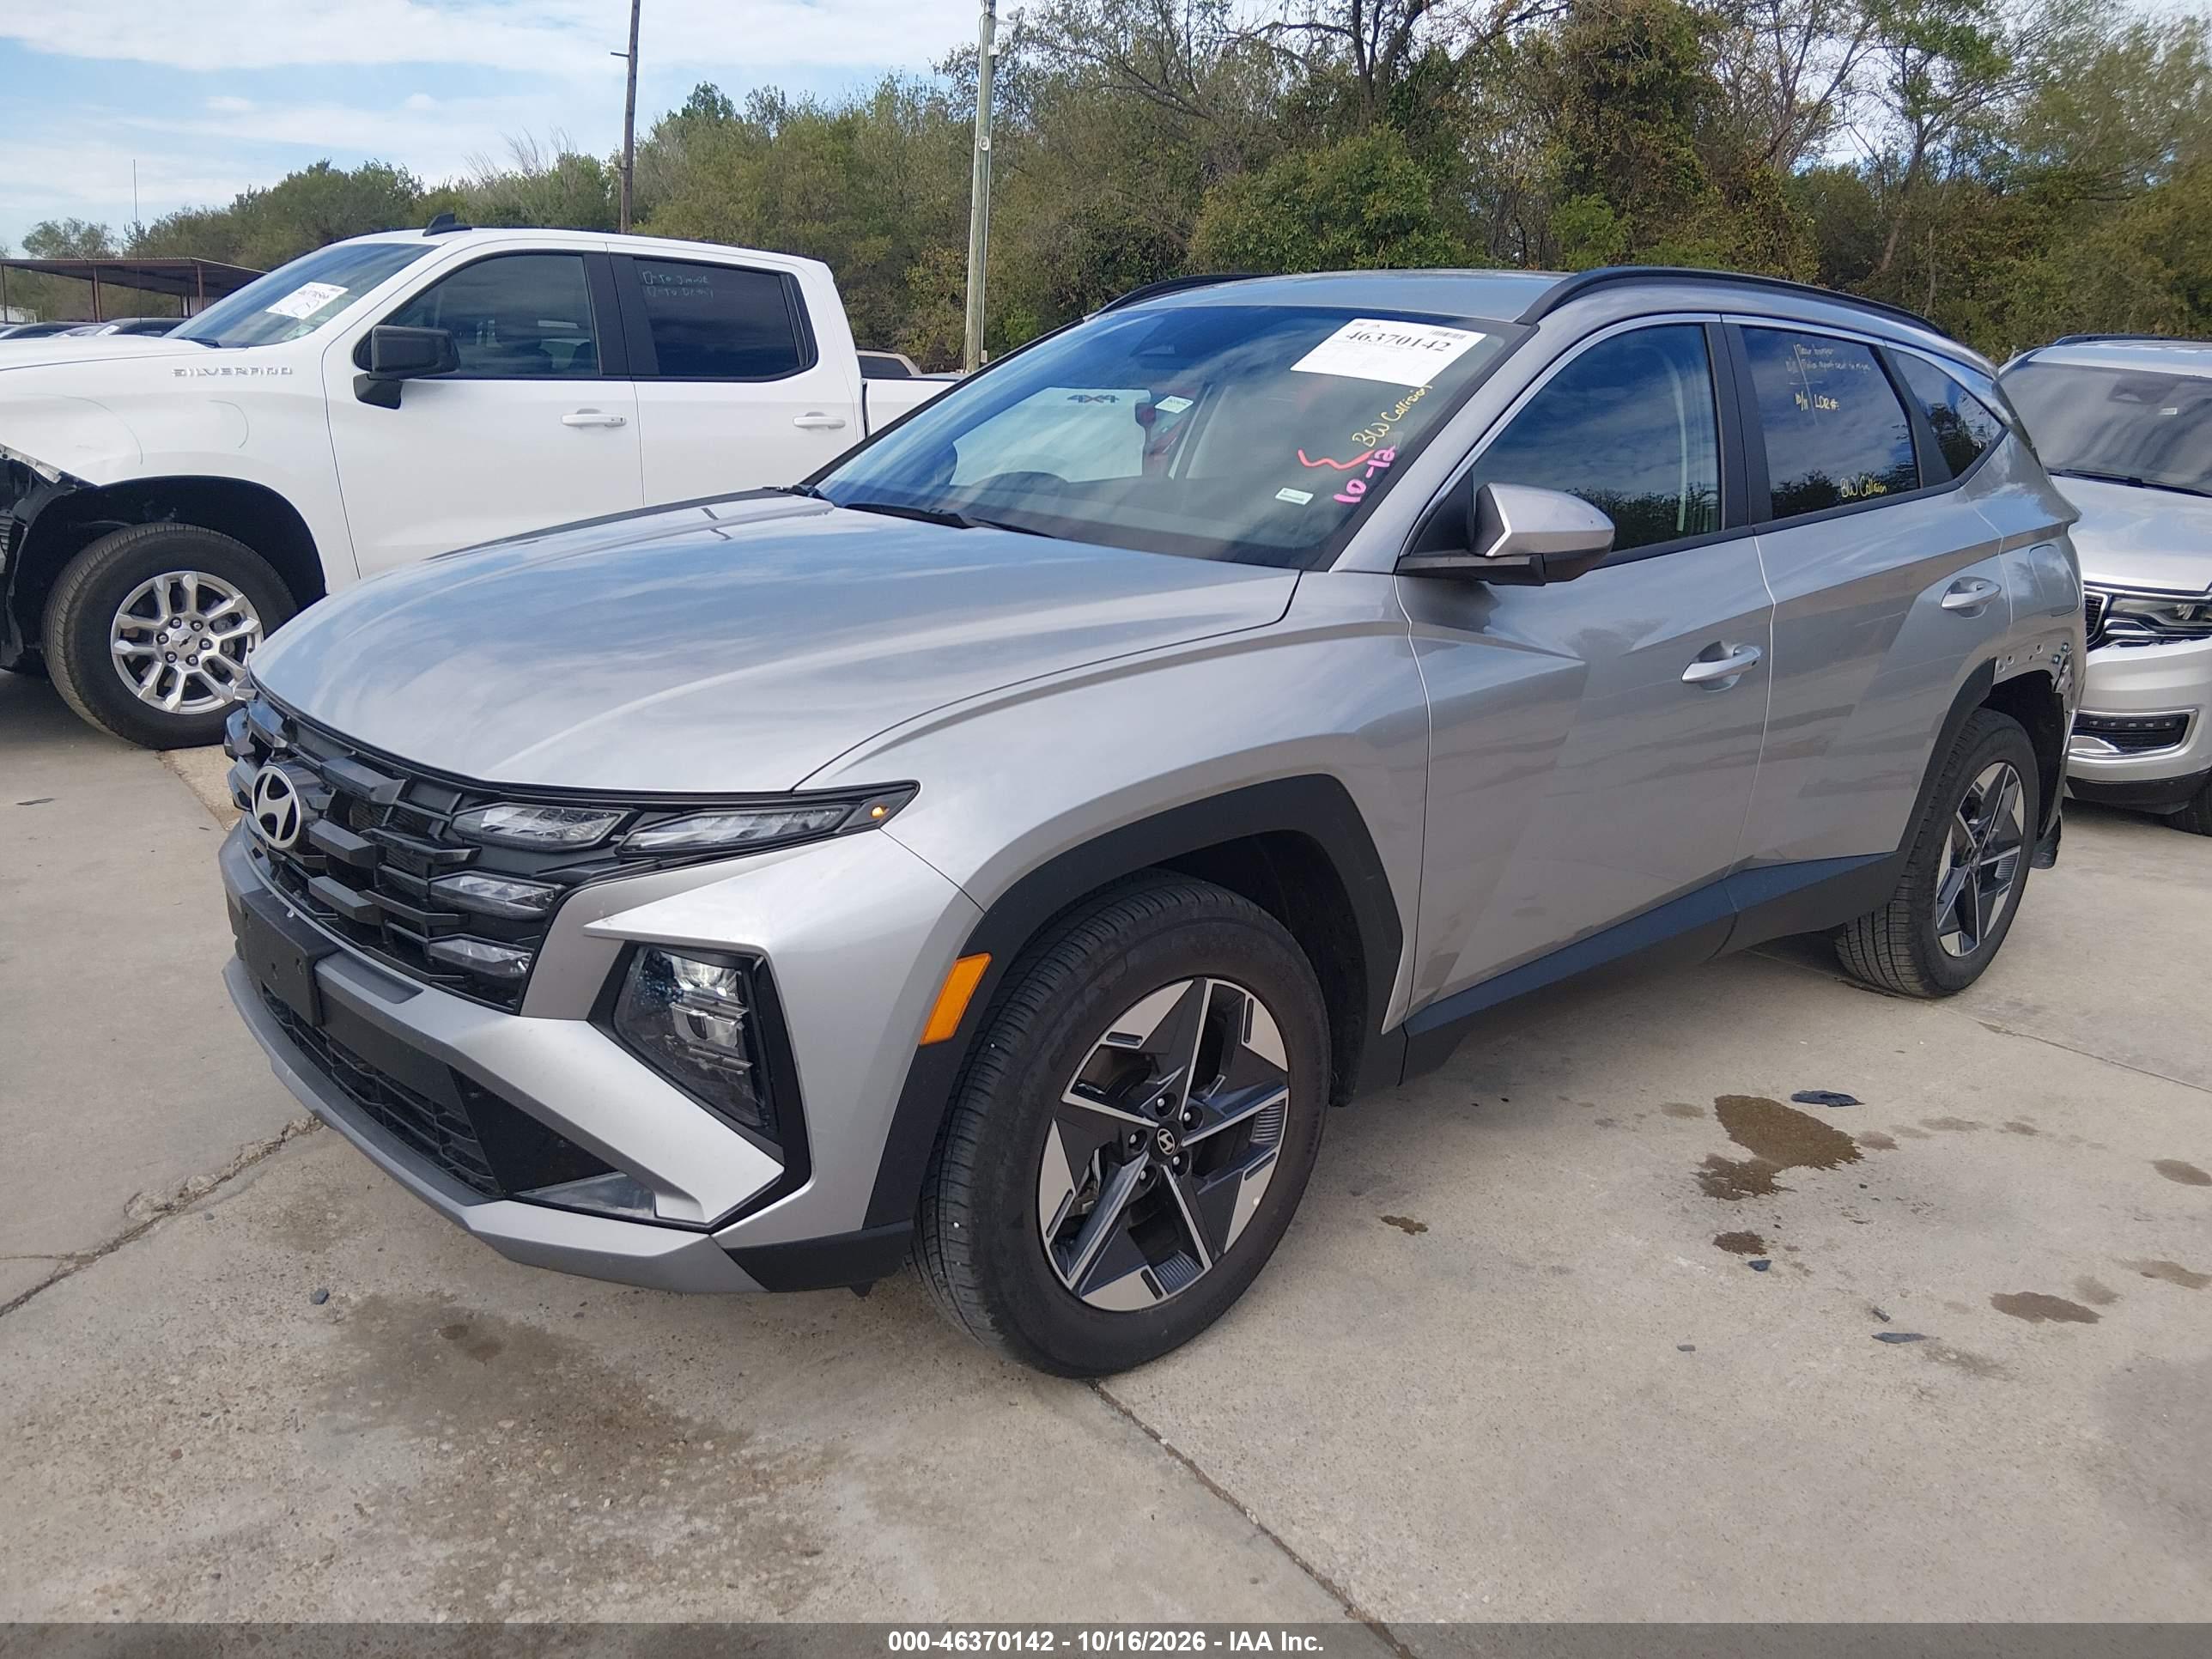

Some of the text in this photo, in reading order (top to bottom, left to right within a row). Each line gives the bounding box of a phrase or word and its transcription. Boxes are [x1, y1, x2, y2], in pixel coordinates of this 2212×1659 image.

[1346, 330, 1451, 352] 46370142
[172, 367, 293, 378] SILVERADO
[1333, 445, 1396, 503] 10-12
